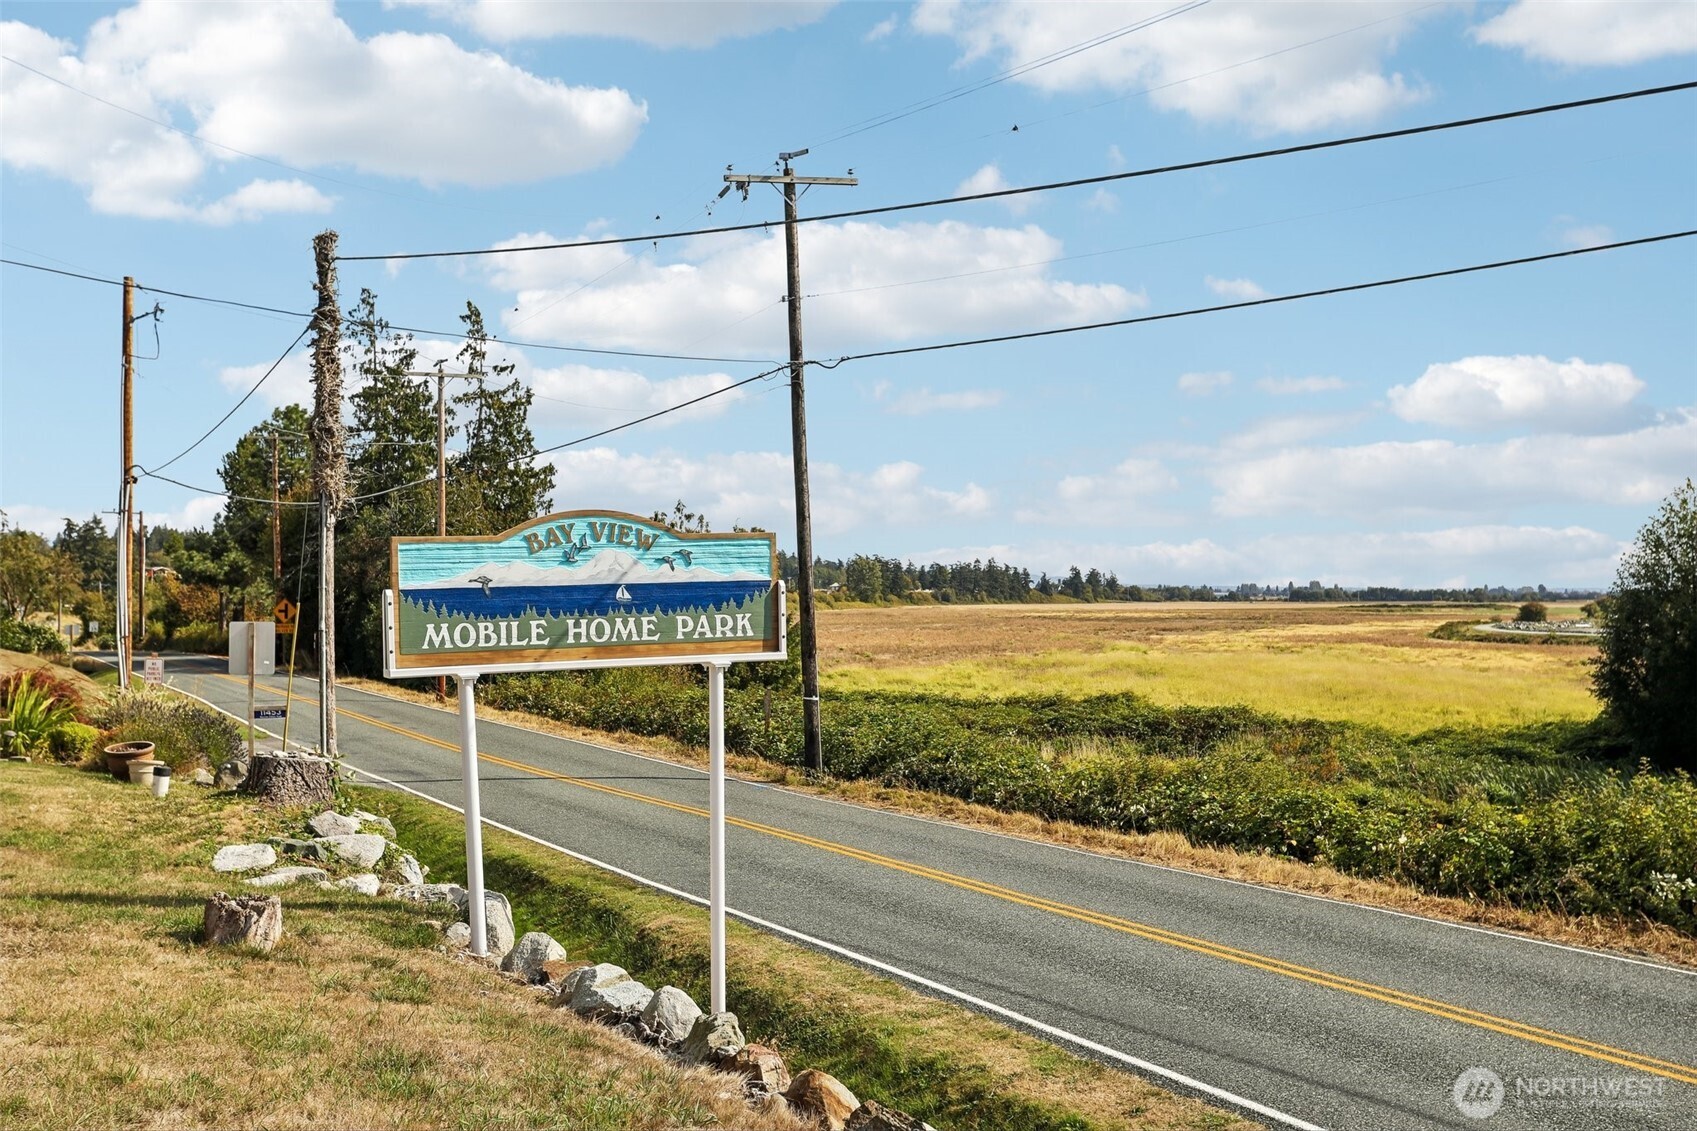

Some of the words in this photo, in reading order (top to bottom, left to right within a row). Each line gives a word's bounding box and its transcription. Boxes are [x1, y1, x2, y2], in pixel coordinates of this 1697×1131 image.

[524, 522, 576, 555] BAY
[588, 521, 660, 551] VIEW
[421, 619, 550, 649] MOBILE
[566, 616, 661, 643] HOME
[675, 613, 755, 639] PARK
